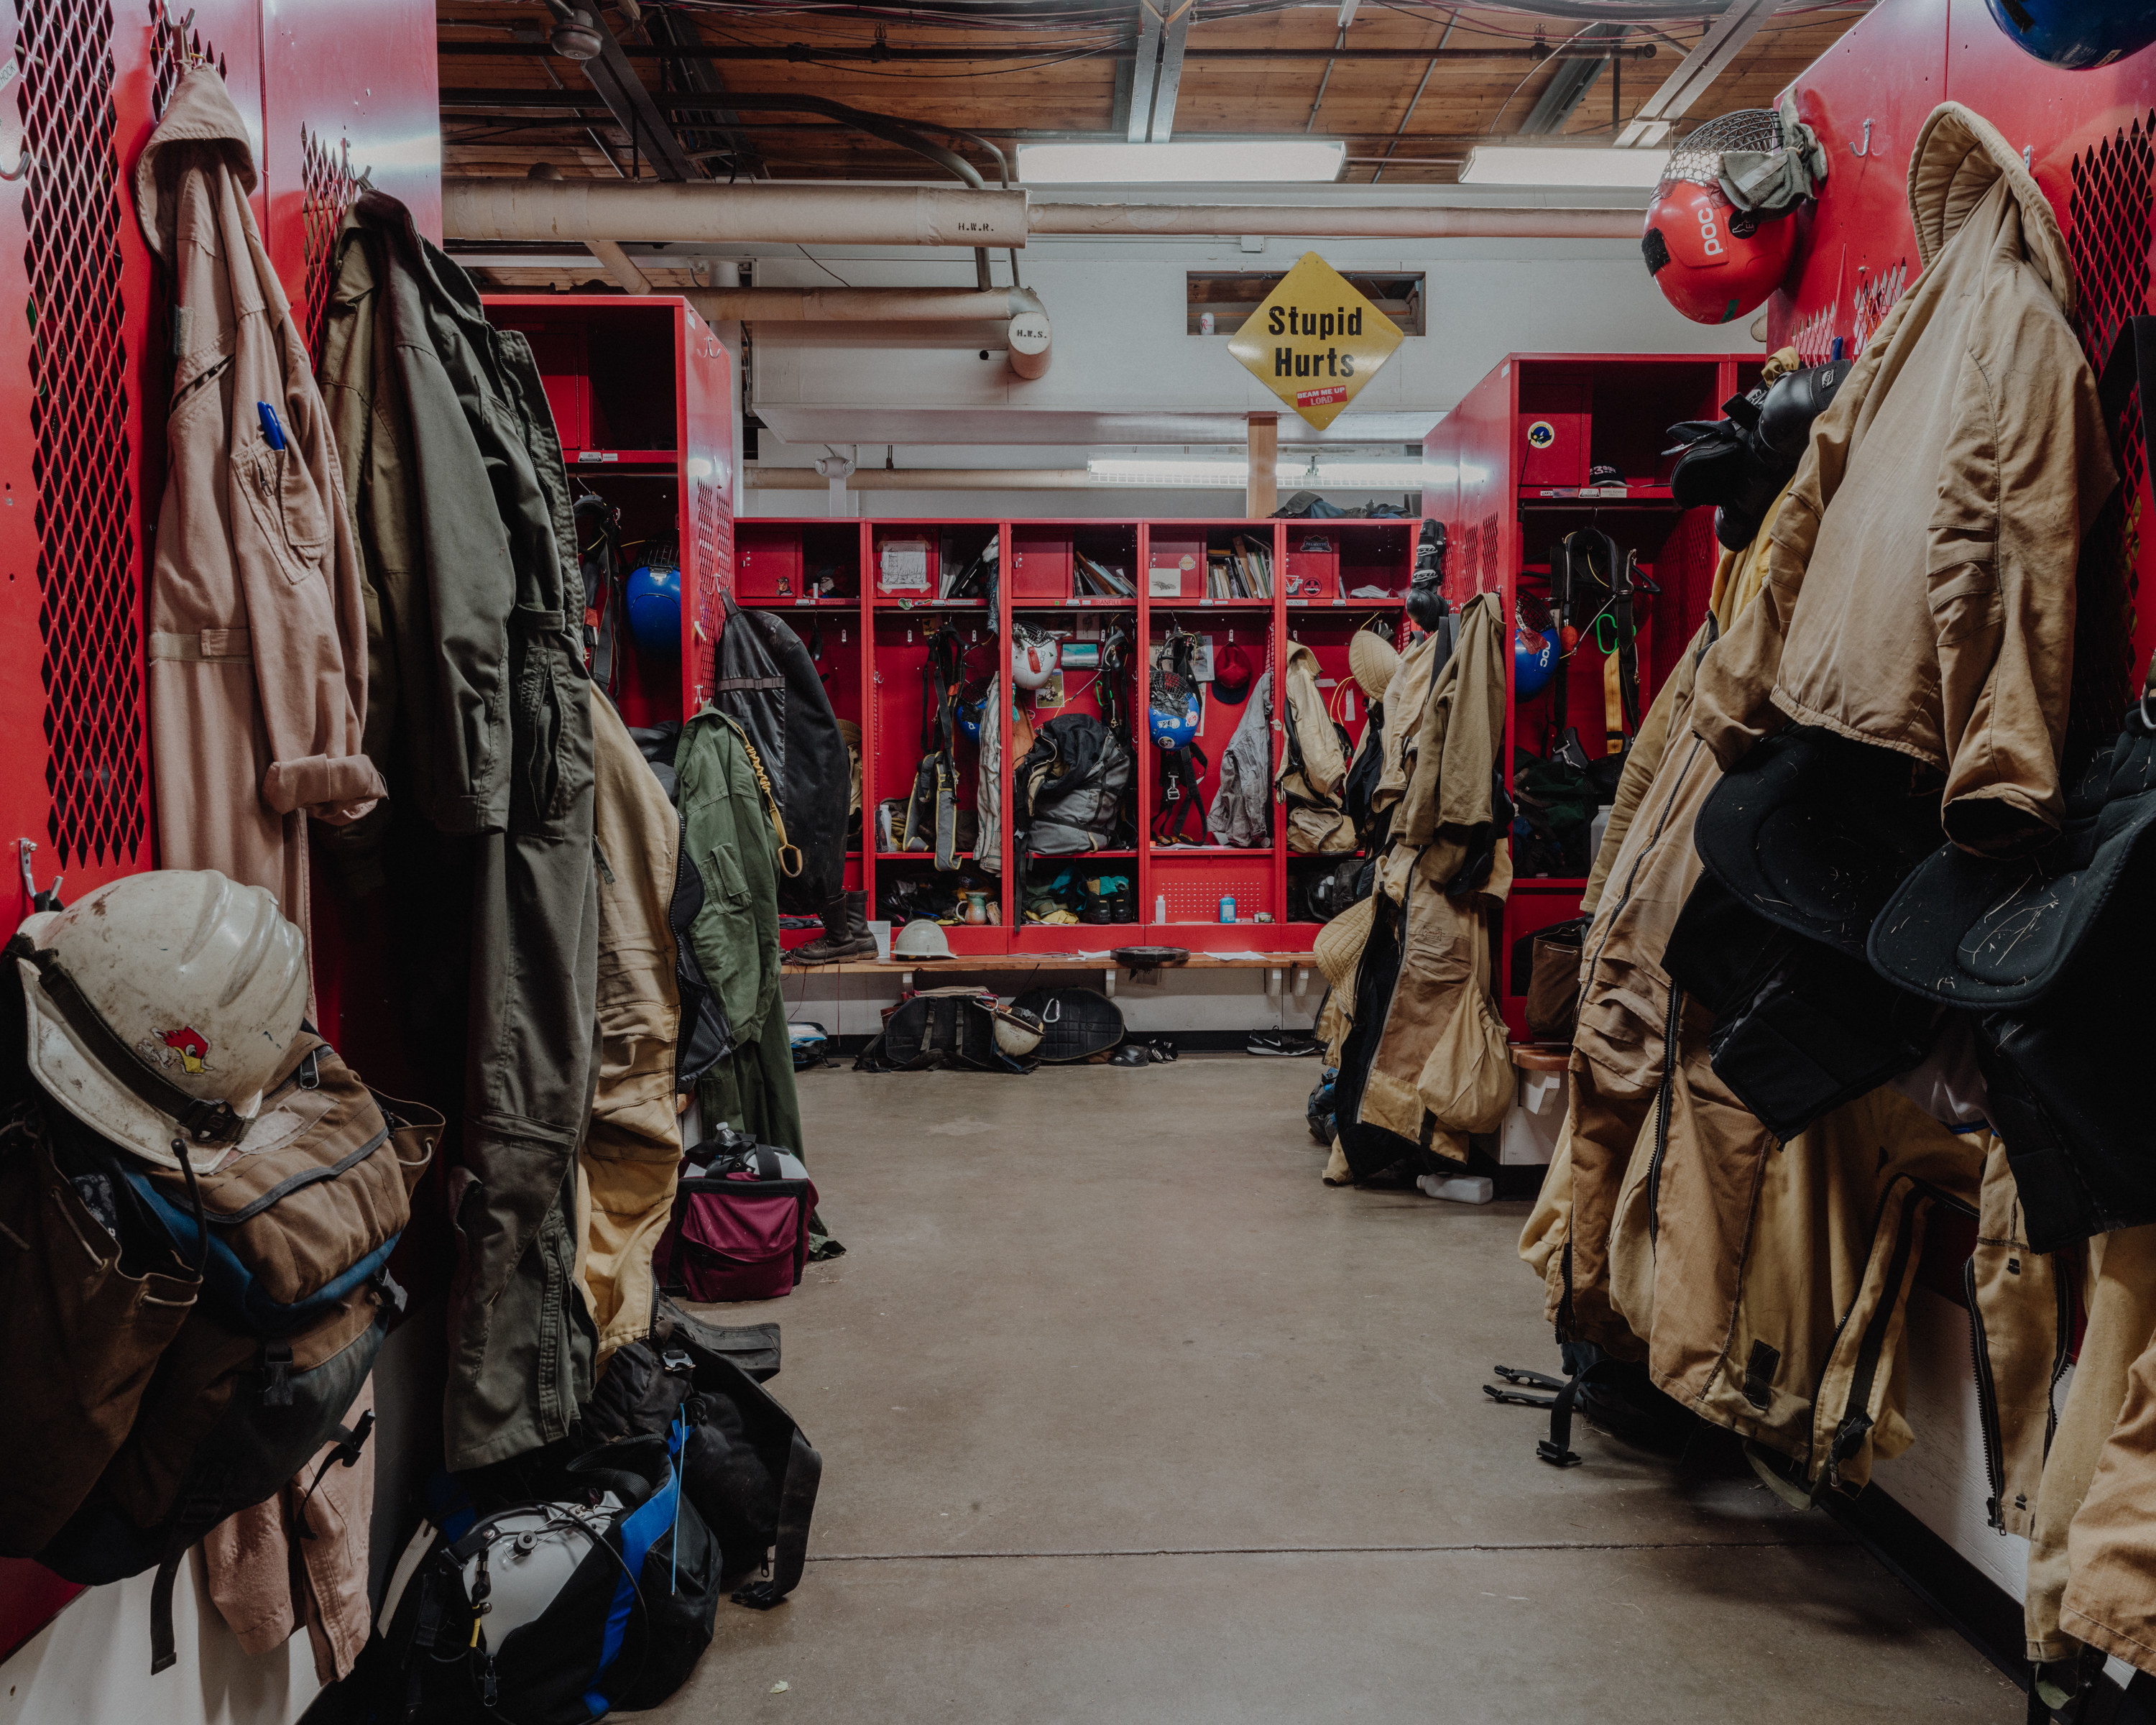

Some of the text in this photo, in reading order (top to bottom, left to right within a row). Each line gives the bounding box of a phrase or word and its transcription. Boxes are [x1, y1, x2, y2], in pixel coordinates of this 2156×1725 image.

[958, 222, 994, 231] H.W.R.
[1697, 207, 1723, 256] poc
[1268, 305, 1362, 340] Stupid
[1017, 329, 1047, 339] H.W.S.
[1275, 347, 1355, 377] Hurts
[1296, 390, 1319, 399] BEAM
[1310, 395, 1333, 405] LORD
